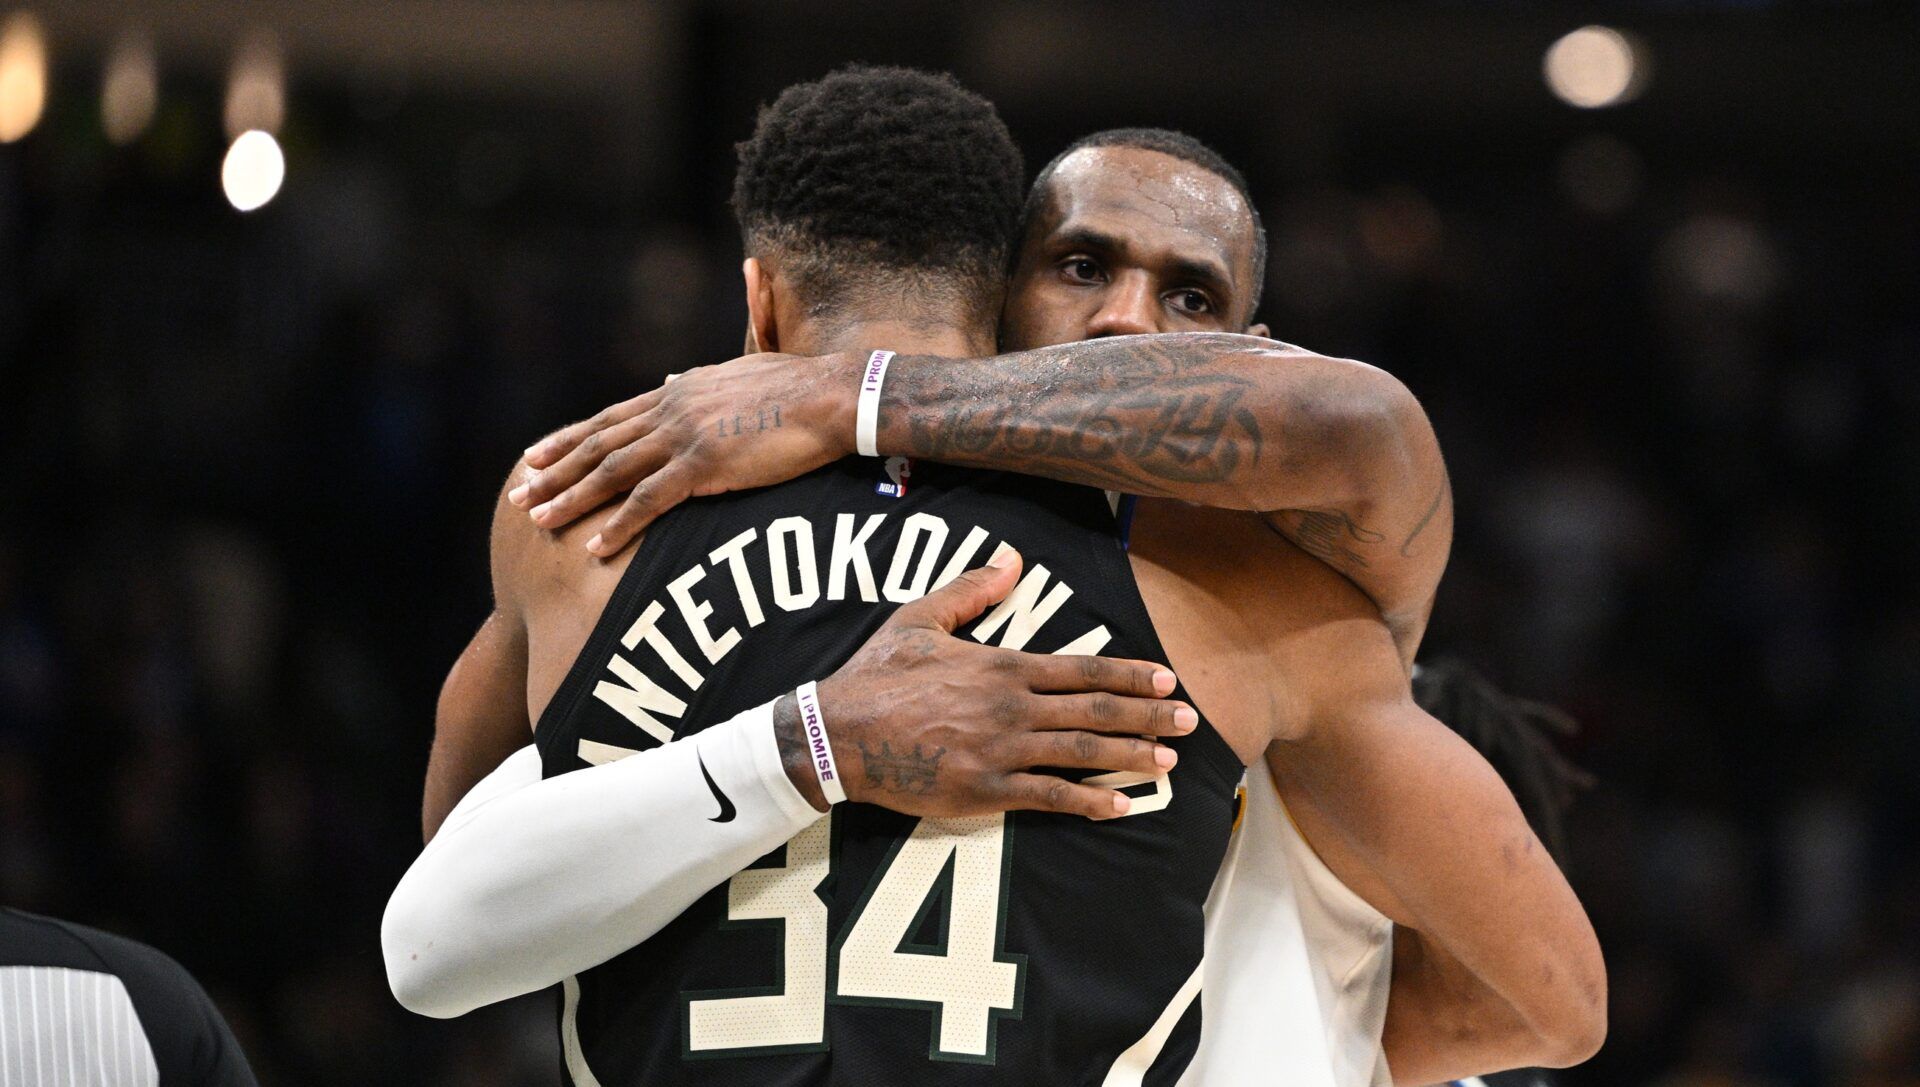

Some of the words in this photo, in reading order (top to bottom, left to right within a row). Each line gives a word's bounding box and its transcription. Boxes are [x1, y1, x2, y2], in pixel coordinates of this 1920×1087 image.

[878, 482, 895, 494] NBA
[803, 703, 834, 781] PROMISE
[682, 806, 1026, 1063] 34
